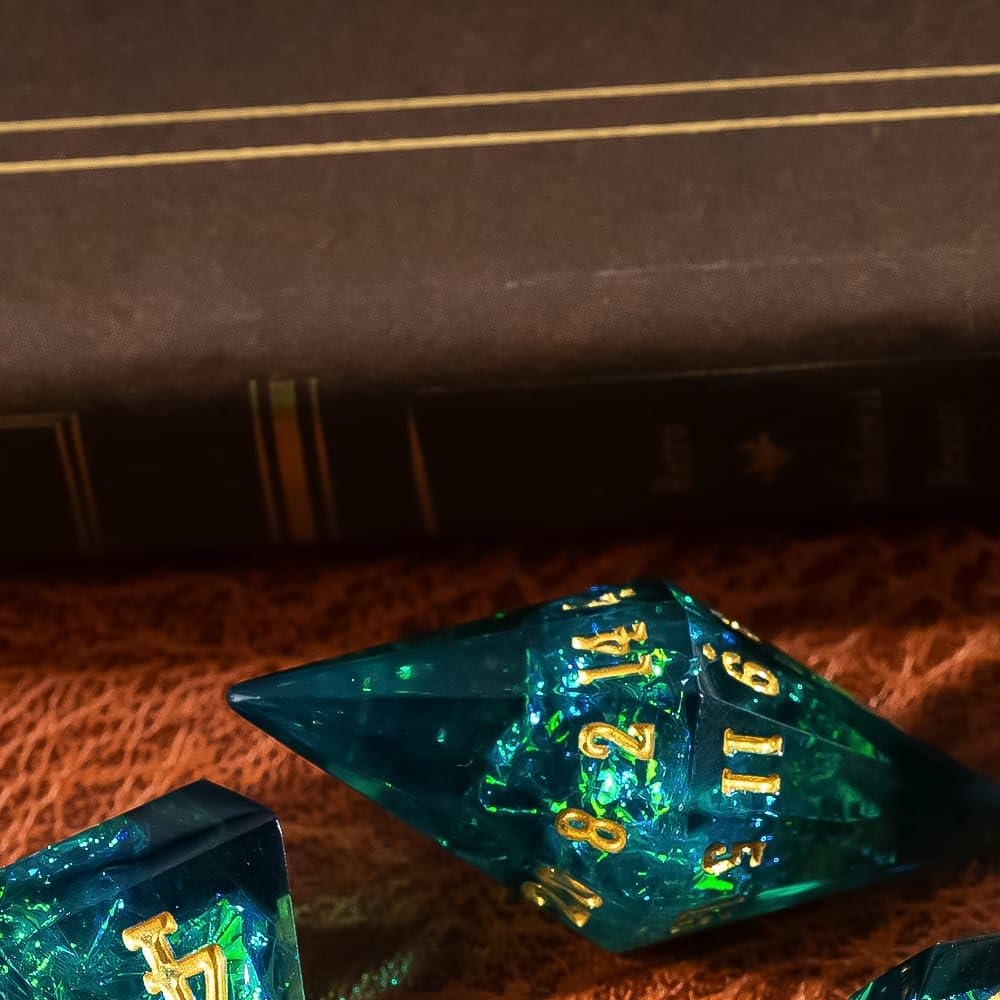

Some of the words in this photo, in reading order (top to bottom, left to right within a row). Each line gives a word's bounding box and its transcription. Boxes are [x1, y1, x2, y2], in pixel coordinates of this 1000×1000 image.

[577, 721, 657, 762] 2
[721, 726, 785, 797] 11
[555, 806, 628, 855] 8
